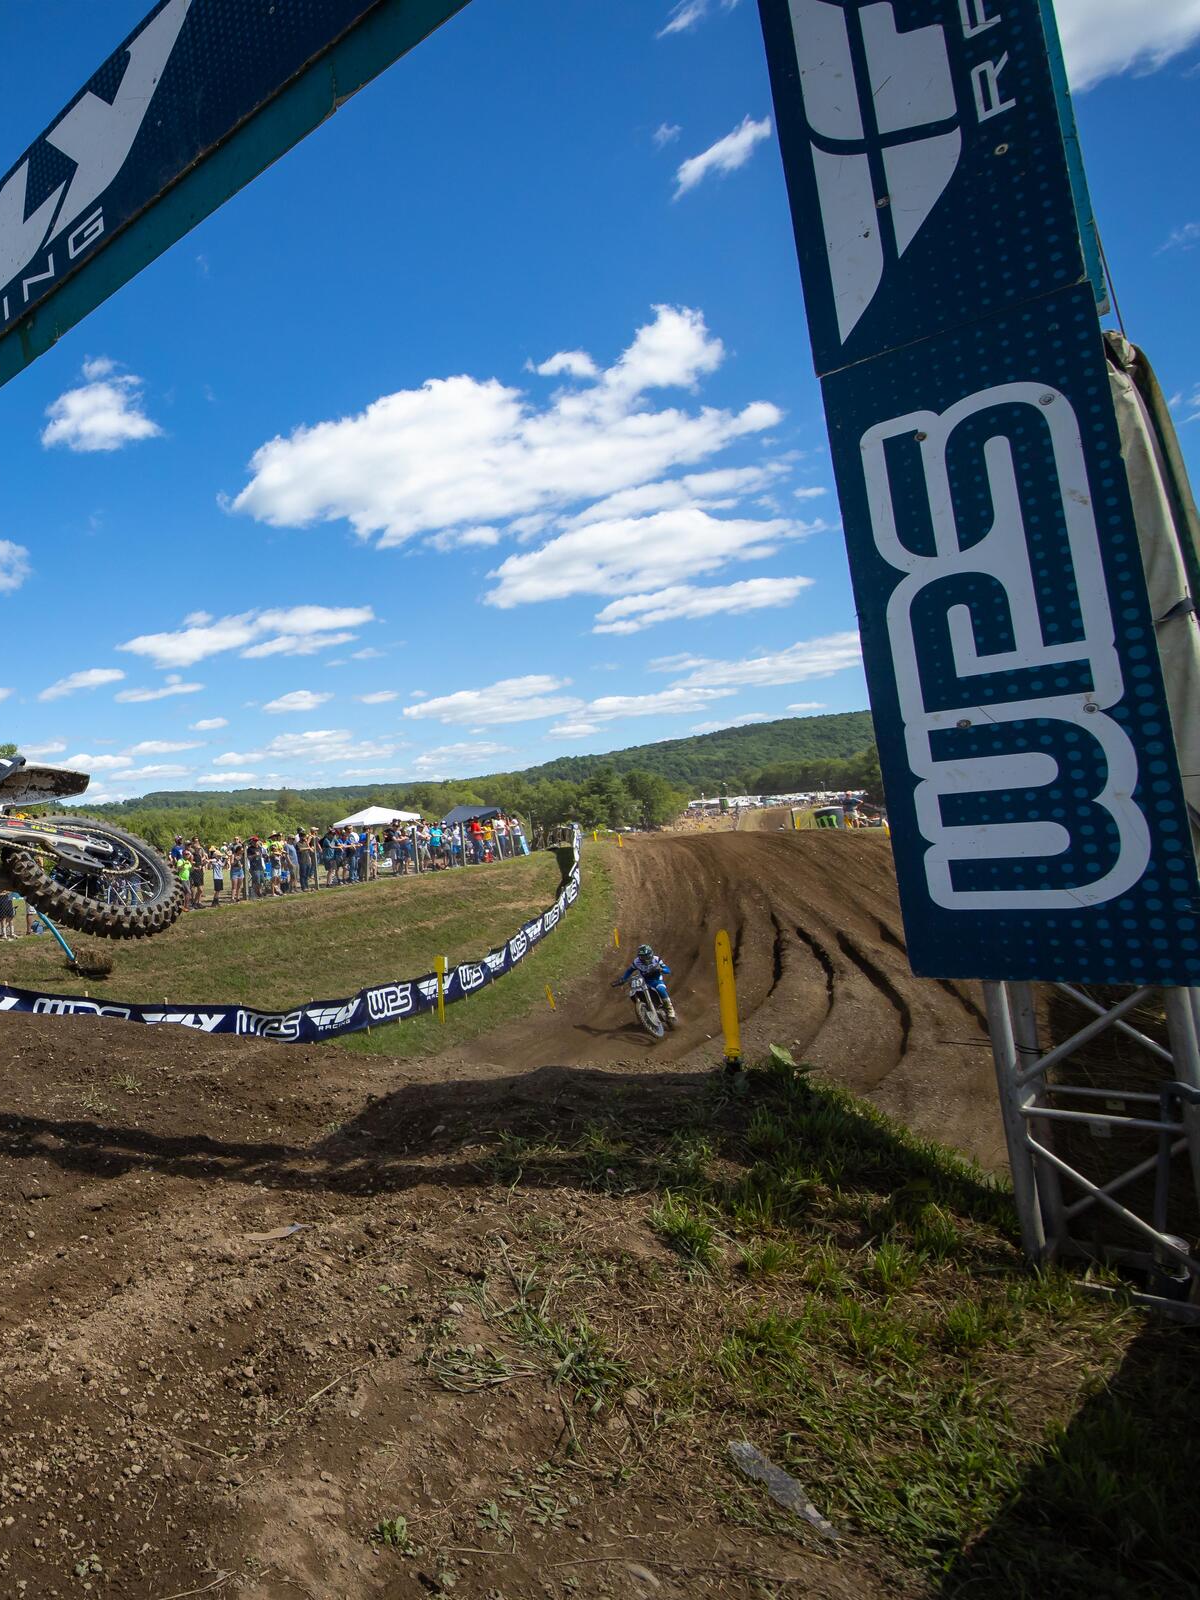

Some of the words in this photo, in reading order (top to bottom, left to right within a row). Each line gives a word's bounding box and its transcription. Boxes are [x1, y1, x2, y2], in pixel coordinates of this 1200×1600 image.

[860, 381, 1152, 910] WPS
[305, 998, 362, 1026] FLY
[366, 983, 413, 1020] WPS
[318, 1019, 351, 1032] RACING
